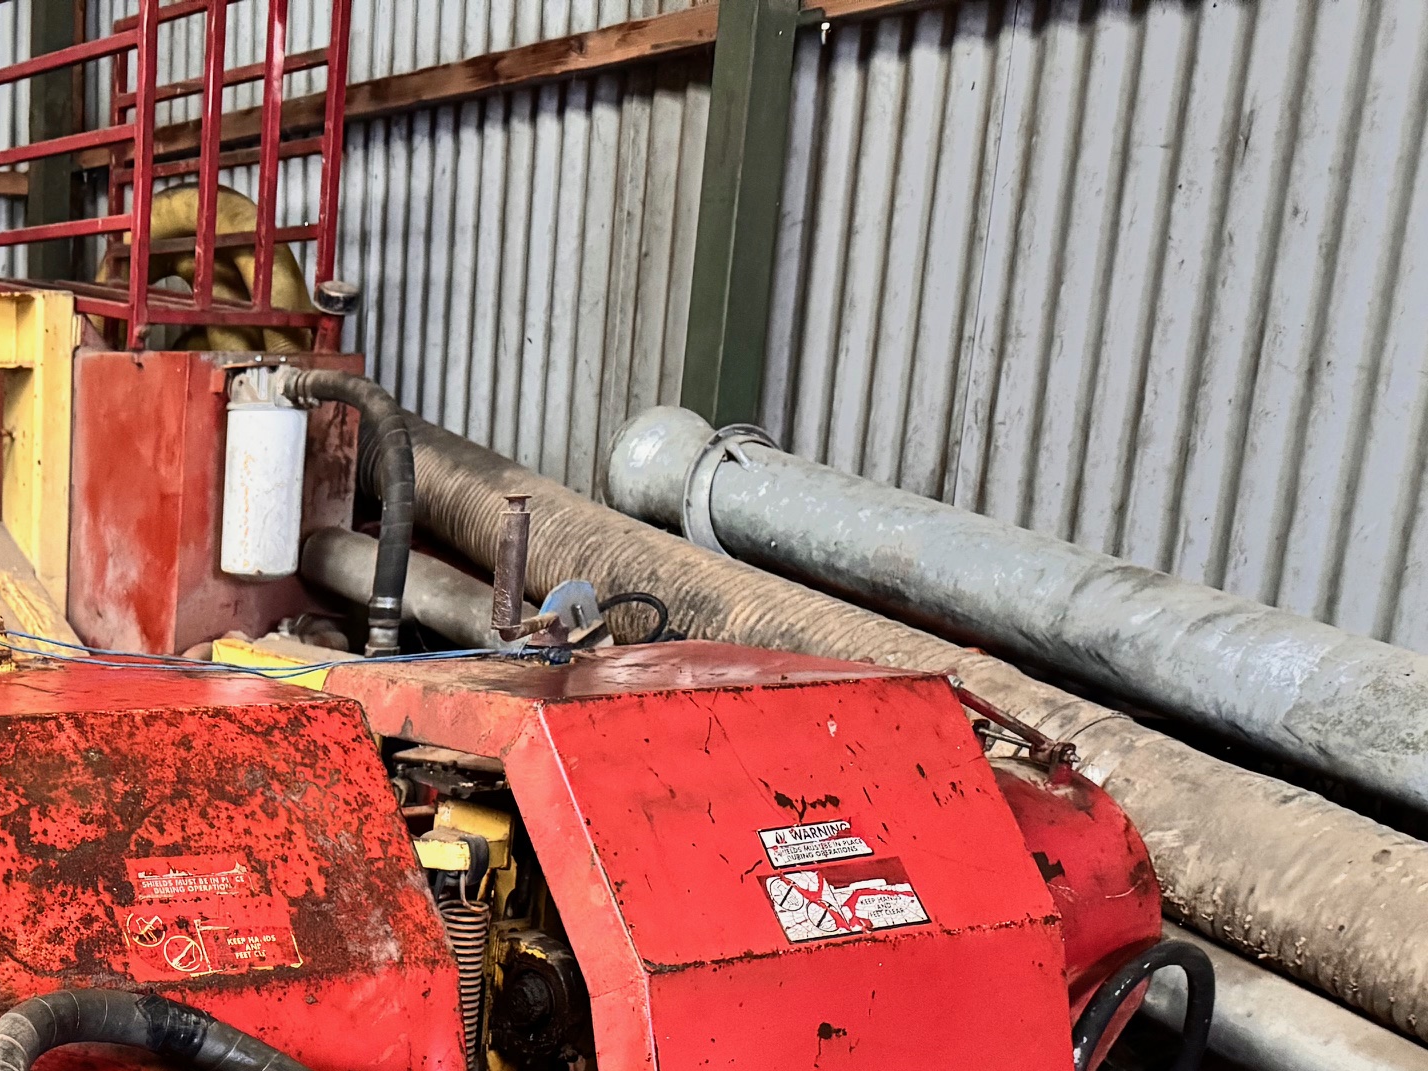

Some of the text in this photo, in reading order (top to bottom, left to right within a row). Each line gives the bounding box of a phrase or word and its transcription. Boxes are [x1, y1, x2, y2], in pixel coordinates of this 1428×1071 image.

[789, 823, 848, 841] WARNING
[142, 879, 173, 888] SHIELDS
[175, 878, 196, 886] MUST
[198, 877, 208, 885] BE
[221, 875, 245, 883] PLCE
[153, 883, 235, 895] DURING OPERATION
[860, 897, 875, 905] KEEP
[877, 902, 892, 910] AND
[885, 907, 904, 916] CLEAR
[227, 937, 246, 946] KEEP
[235, 951, 251, 959] FEET
